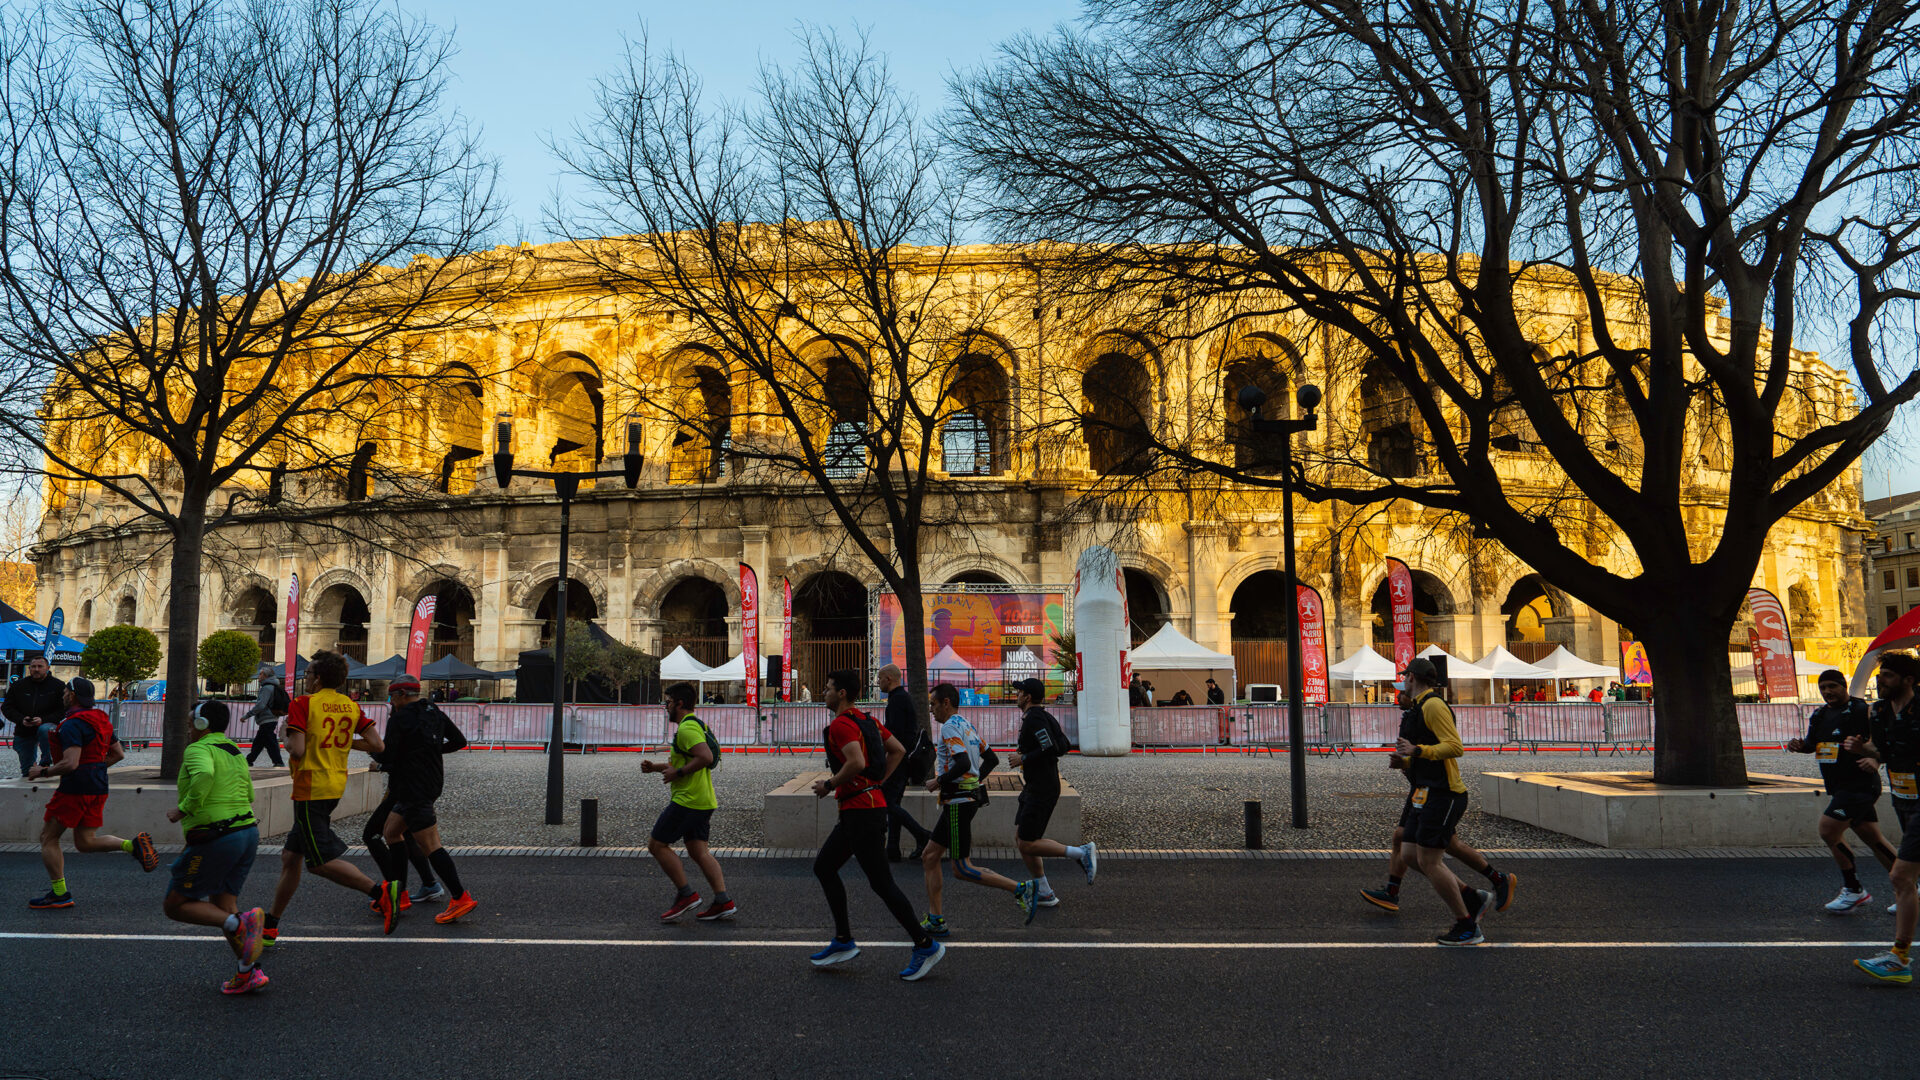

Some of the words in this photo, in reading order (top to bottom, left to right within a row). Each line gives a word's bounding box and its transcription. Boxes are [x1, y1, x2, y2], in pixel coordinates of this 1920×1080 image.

[927, 595, 975, 610] URBAN
[1004, 609, 1031, 623] 100
[1005, 625, 1035, 634] INSOLITE
[981, 618, 994, 657] TRAIL
[1005, 636, 1027, 645] FESTIF
[1006, 650, 1035, 662] NIMES
[1007, 662, 1038, 673] URBAN
[322, 703, 353, 713] CHARLES
[320, 716, 353, 749] 23
